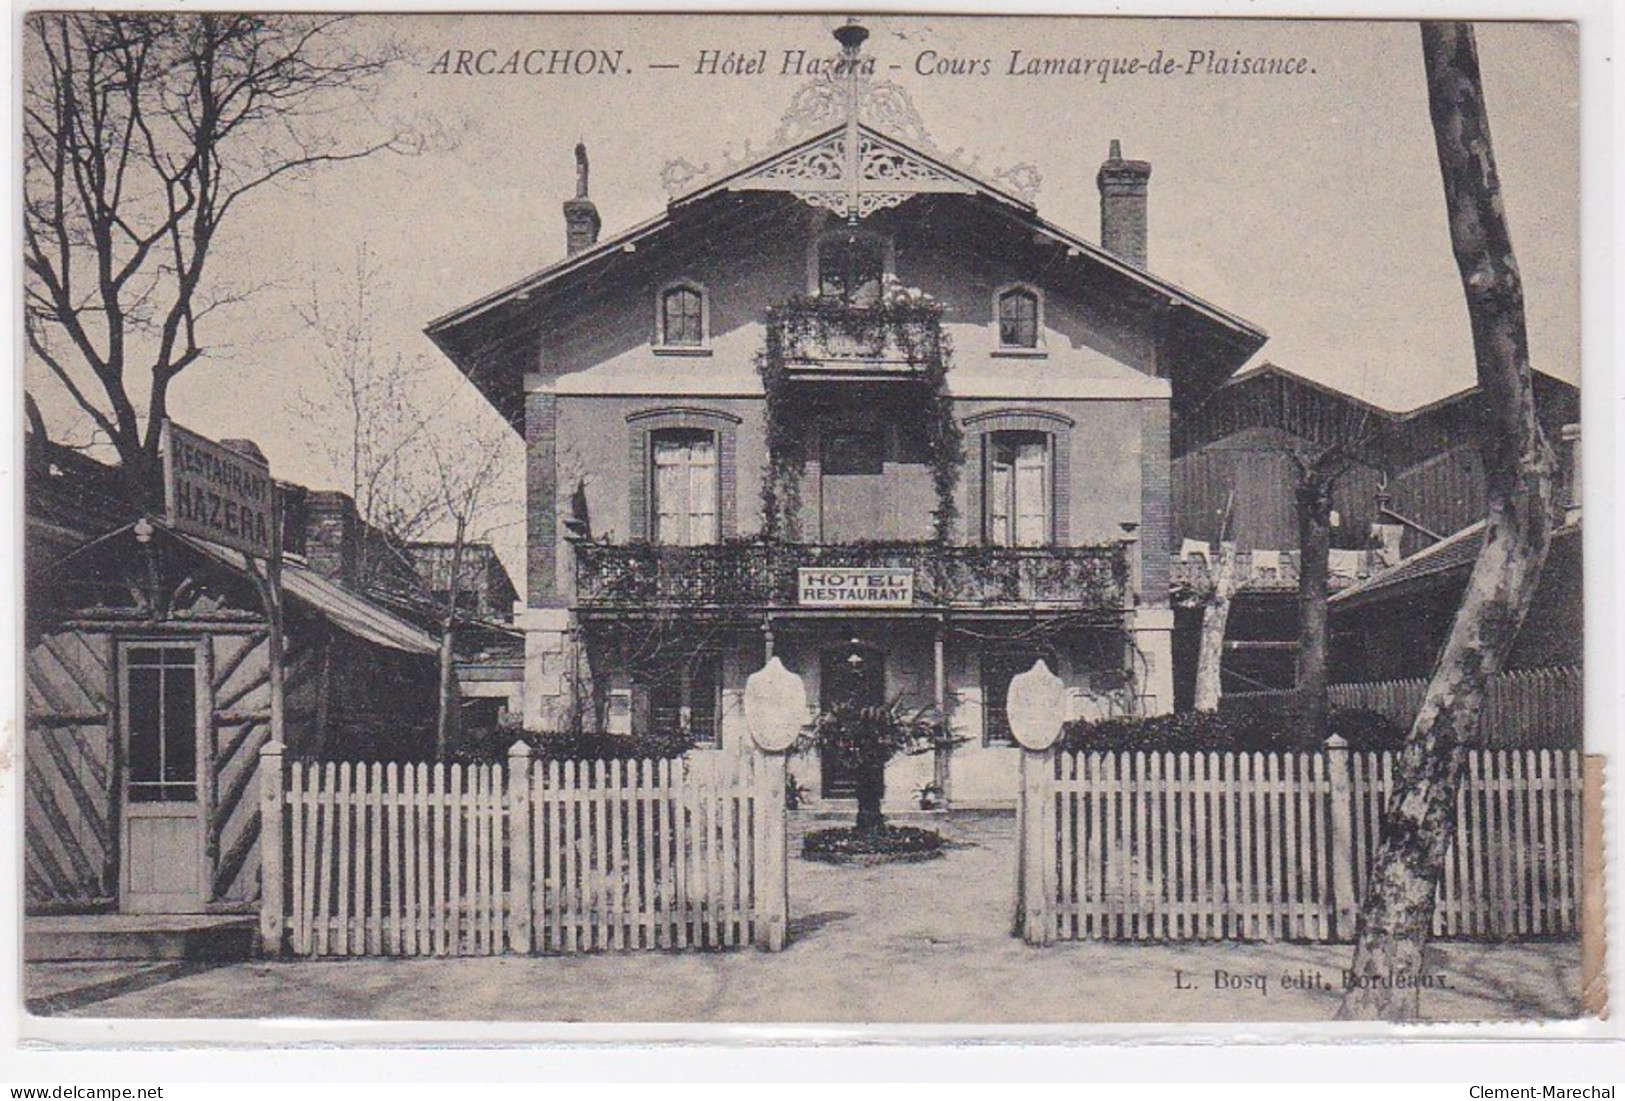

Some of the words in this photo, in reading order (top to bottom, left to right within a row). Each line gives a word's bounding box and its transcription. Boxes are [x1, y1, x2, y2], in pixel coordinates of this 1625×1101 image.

[172, 436, 267, 502] RESTAURANT
[177, 478, 268, 549] HAZERA
[803, 587, 908, 601] RESTAURANT
[807, 574, 906, 587] HOTEL
